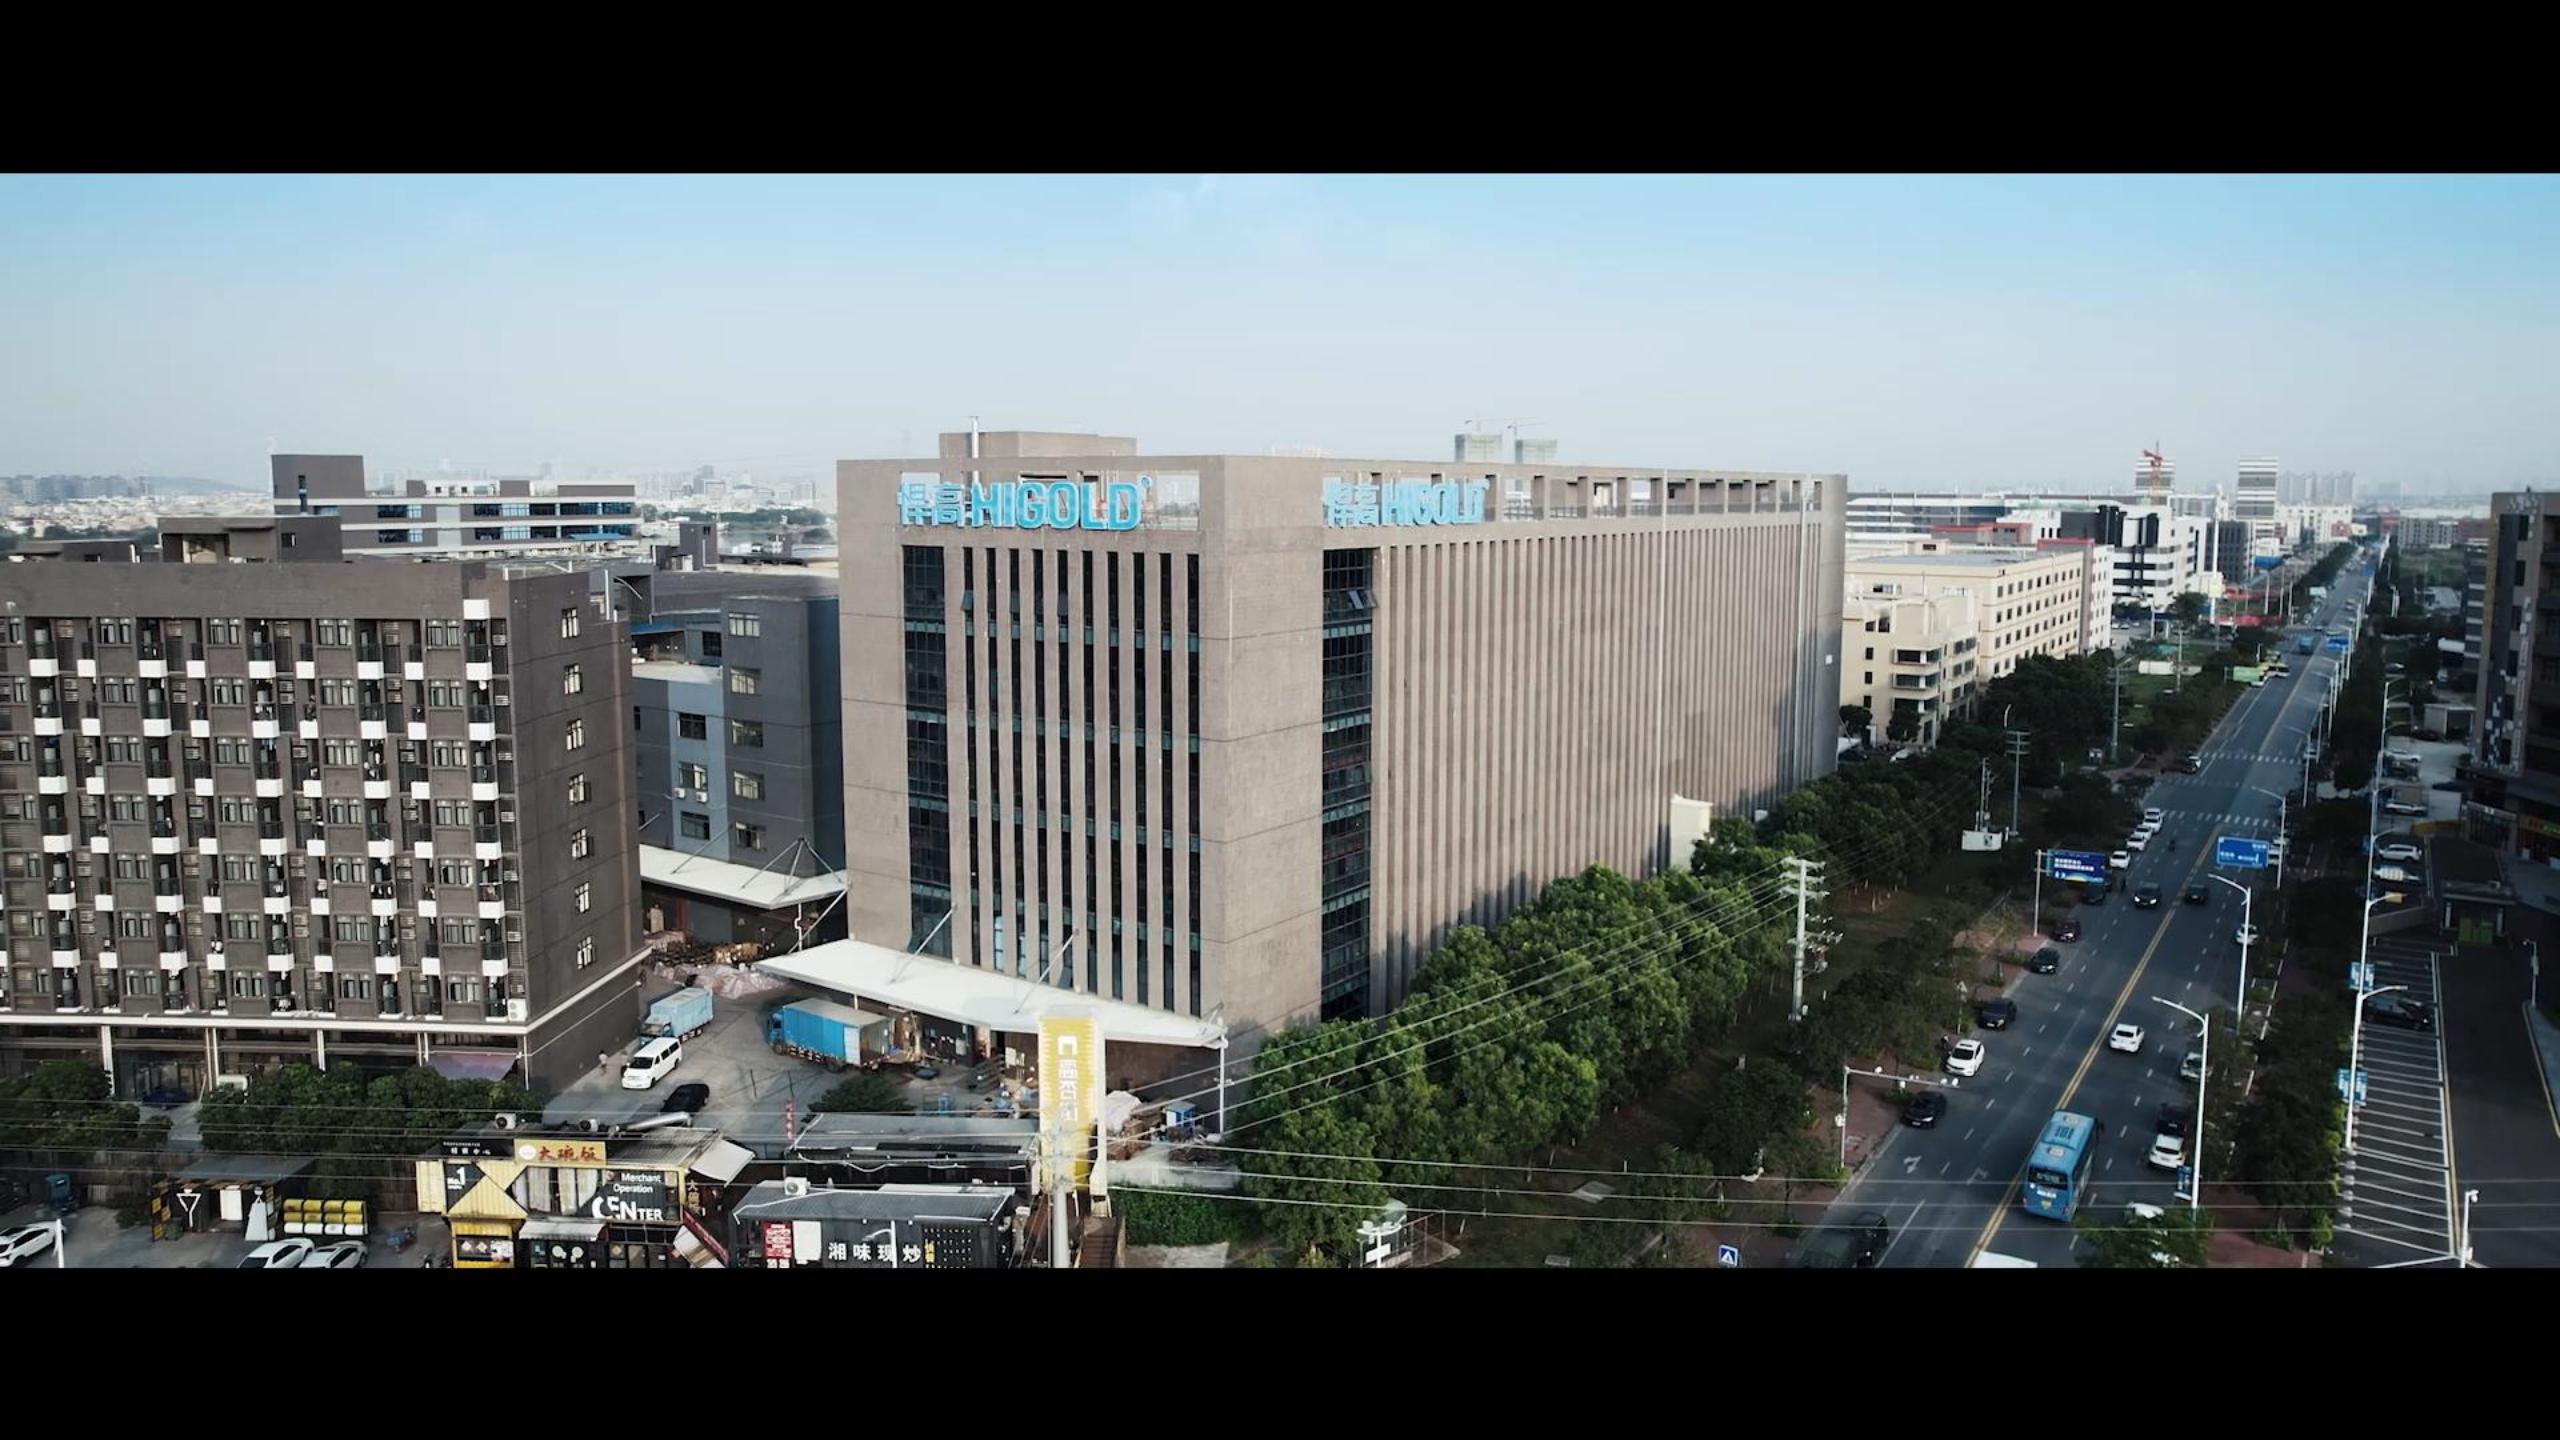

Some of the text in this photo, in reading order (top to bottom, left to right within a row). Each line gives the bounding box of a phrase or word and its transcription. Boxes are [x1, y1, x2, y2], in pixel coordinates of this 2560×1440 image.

[971, 481, 1143, 531] HIGOLD
[621, 1172, 662, 1183] Merchant
[612, 1183, 654, 1194] Operation
[827, 1242, 922, 1264] 湘味现炒
